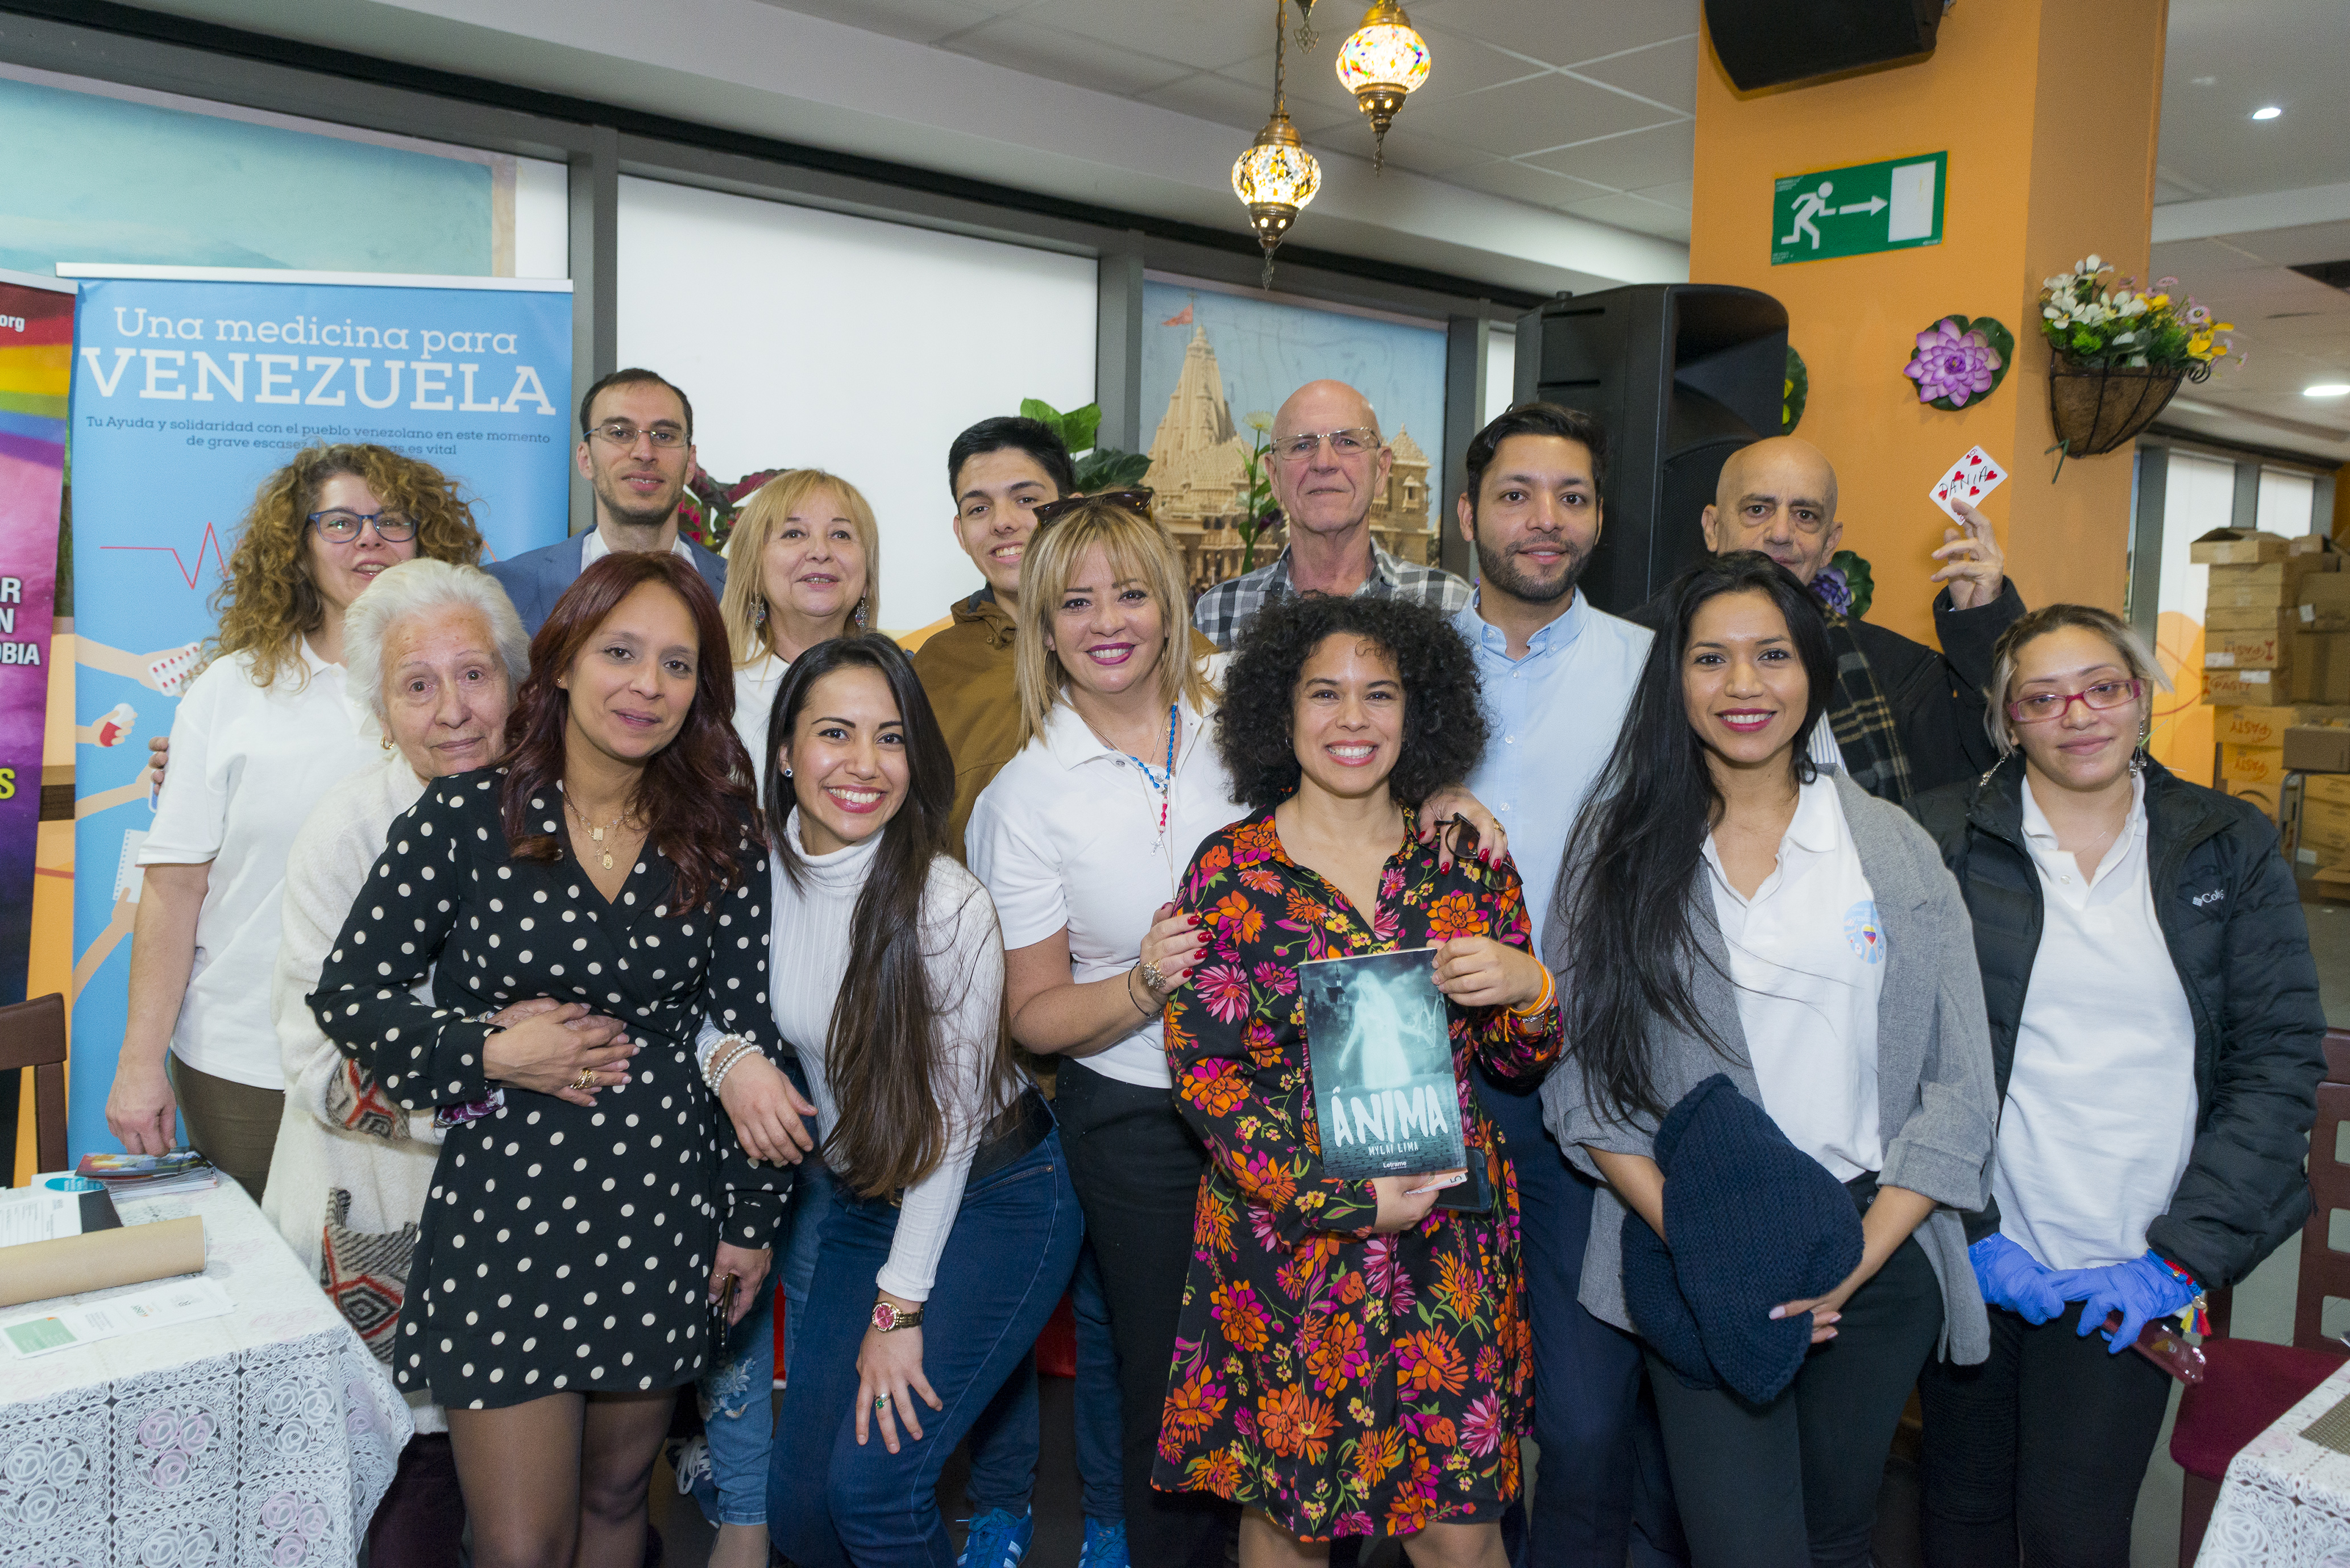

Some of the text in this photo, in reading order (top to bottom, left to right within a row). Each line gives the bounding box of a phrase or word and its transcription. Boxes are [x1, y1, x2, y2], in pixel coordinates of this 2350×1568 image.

[115, 307, 517, 359] Una medicina para
[81, 347, 556, 415] VENEZUELA
[86, 417, 102, 427] Tu
[106, 417, 153, 431] Ayuda
[158, 419, 167, 431] y
[171, 419, 254, 432] solidaridad
[257, 424, 282, 433] con
[286, 423, 297, 434] el
[302, 425, 350, 437] pueblo
[354, 426, 433, 439] venezolano
[456, 431, 483, 440] este
[486, 432, 550, 443] momento
[186, 435, 204, 446] de
[208, 438, 250, 450] grave
[254, 440, 308, 450] escasez
[408, 446, 422, 454] es
[427, 444, 456, 455] vital
[1939, 465, 1989, 499] DANIA
[0, 642, 40, 666] BIA
[1331, 1084, 1448, 1147] ÁNIMA
[1368, 1141, 1419, 1156] MYLAI LIMA
